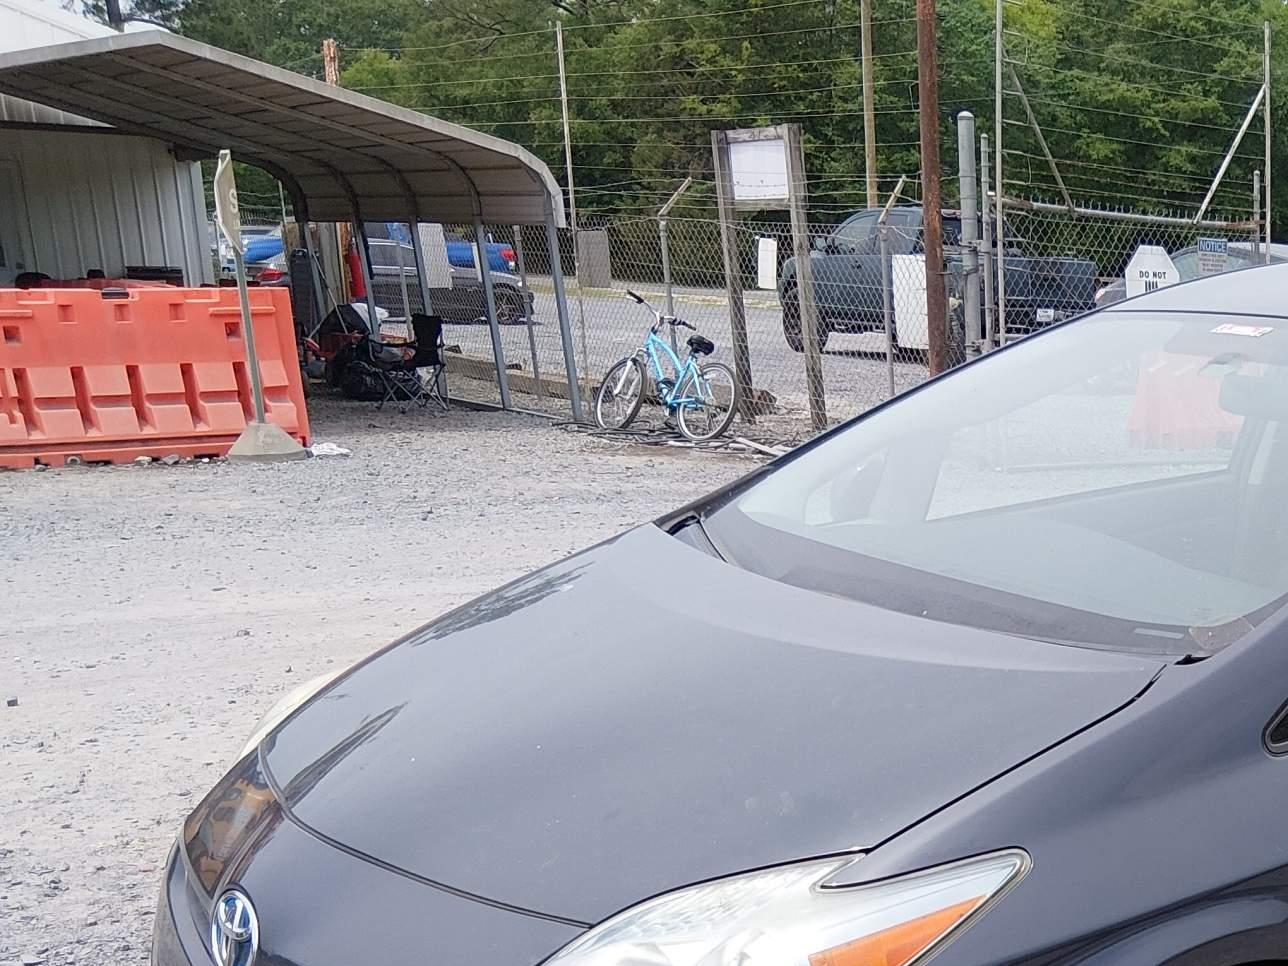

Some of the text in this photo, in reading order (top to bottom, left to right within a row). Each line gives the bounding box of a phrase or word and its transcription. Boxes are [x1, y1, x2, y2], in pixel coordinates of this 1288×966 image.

[1199, 239, 1227, 253] NOTICE
[1139, 270, 1167, 280] DO NOT
